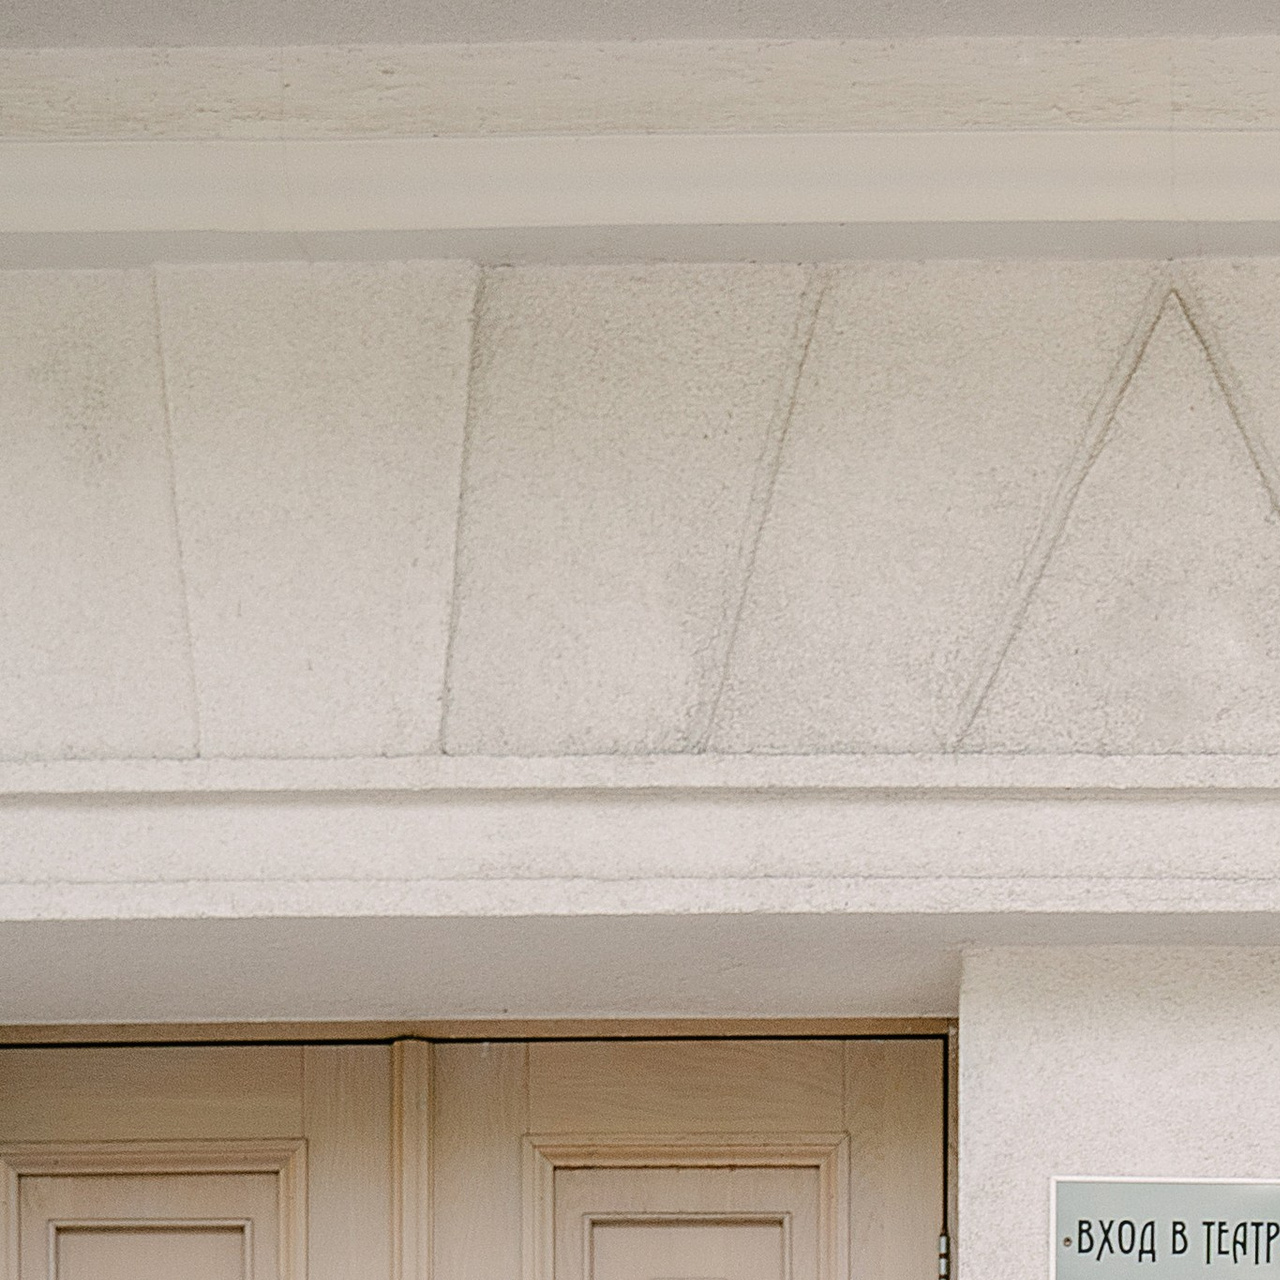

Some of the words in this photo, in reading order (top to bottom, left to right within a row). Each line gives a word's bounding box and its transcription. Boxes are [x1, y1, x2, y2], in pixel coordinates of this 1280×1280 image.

[1078, 1219, 1156, 1263] ВХОД
[1172, 1221, 1188, 1254] В
[1202, 1221, 1280, 1265] ТЕАТР
